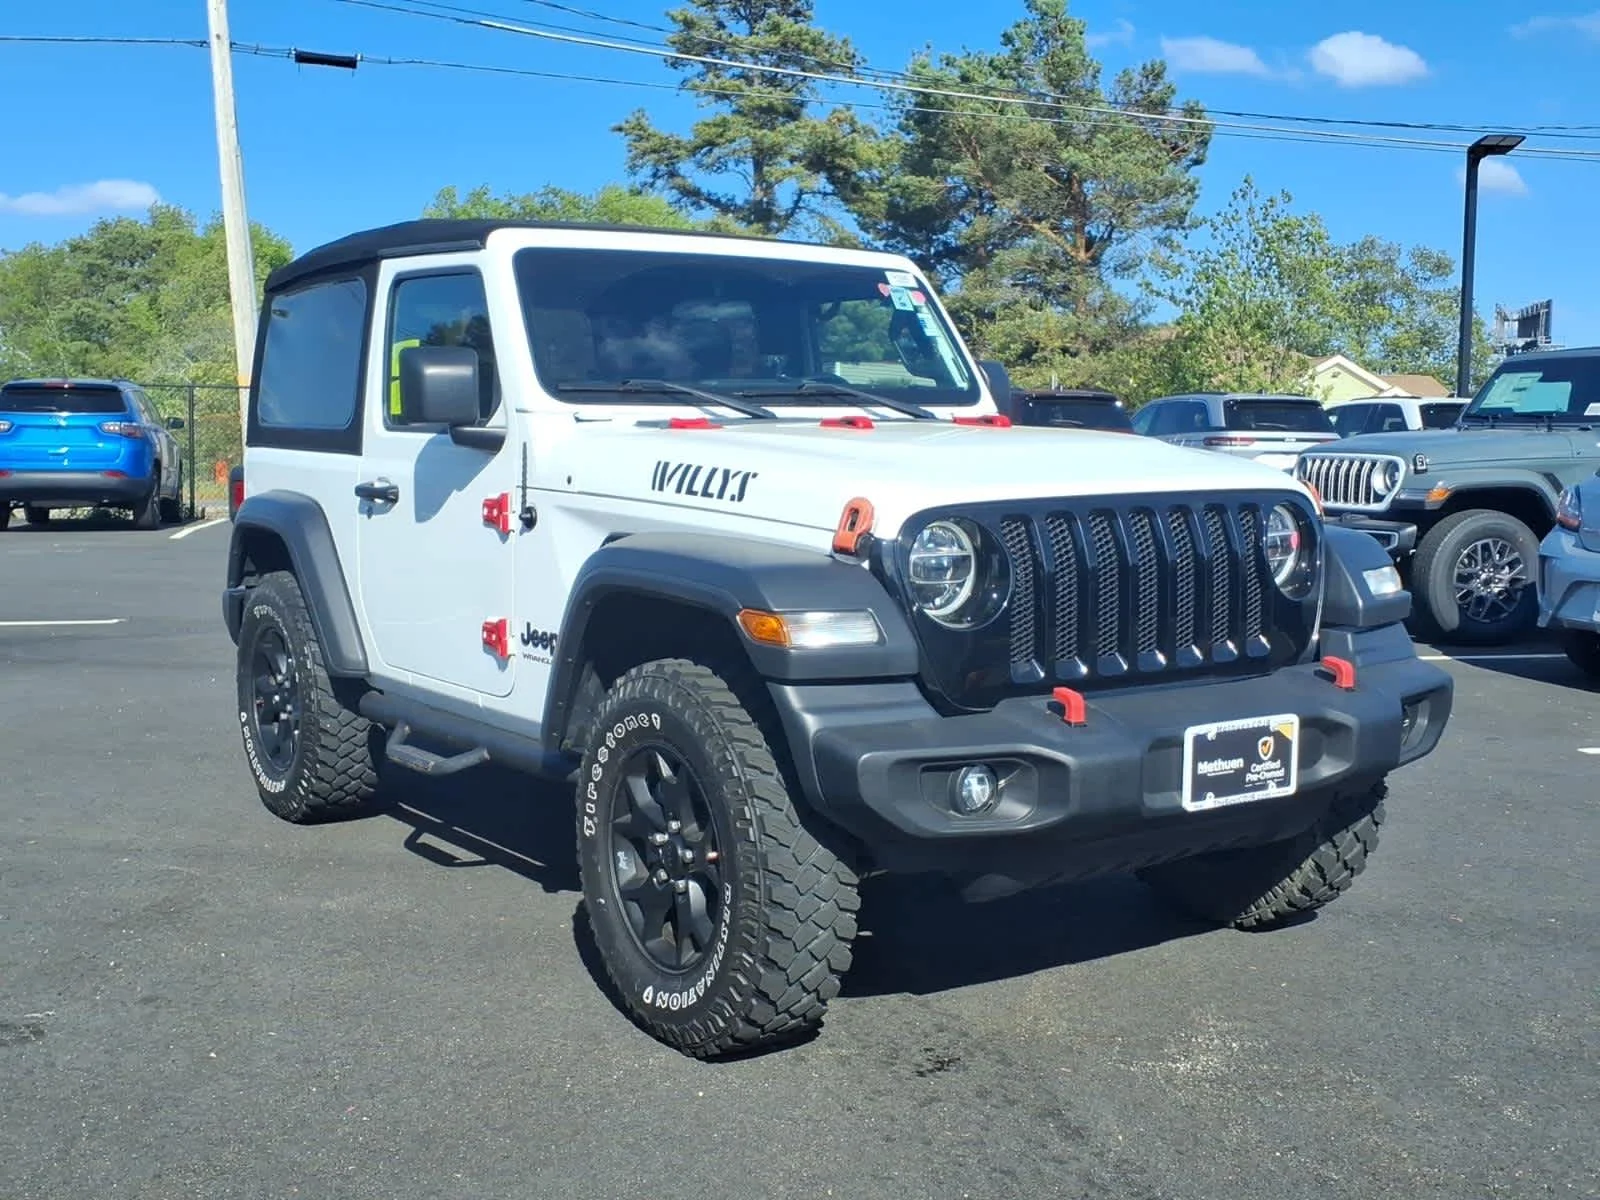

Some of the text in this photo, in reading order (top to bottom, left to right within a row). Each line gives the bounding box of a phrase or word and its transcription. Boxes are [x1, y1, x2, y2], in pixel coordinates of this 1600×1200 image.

[651, 460, 759, 502] WILLYS
[521, 621, 558, 656] Jeep
[583, 713, 650, 837] Firestone
[1197, 758, 1244, 775] Methuen
[1245, 767, 1285, 783] Pre-Owned
[1250, 759, 1281, 773] Certified
